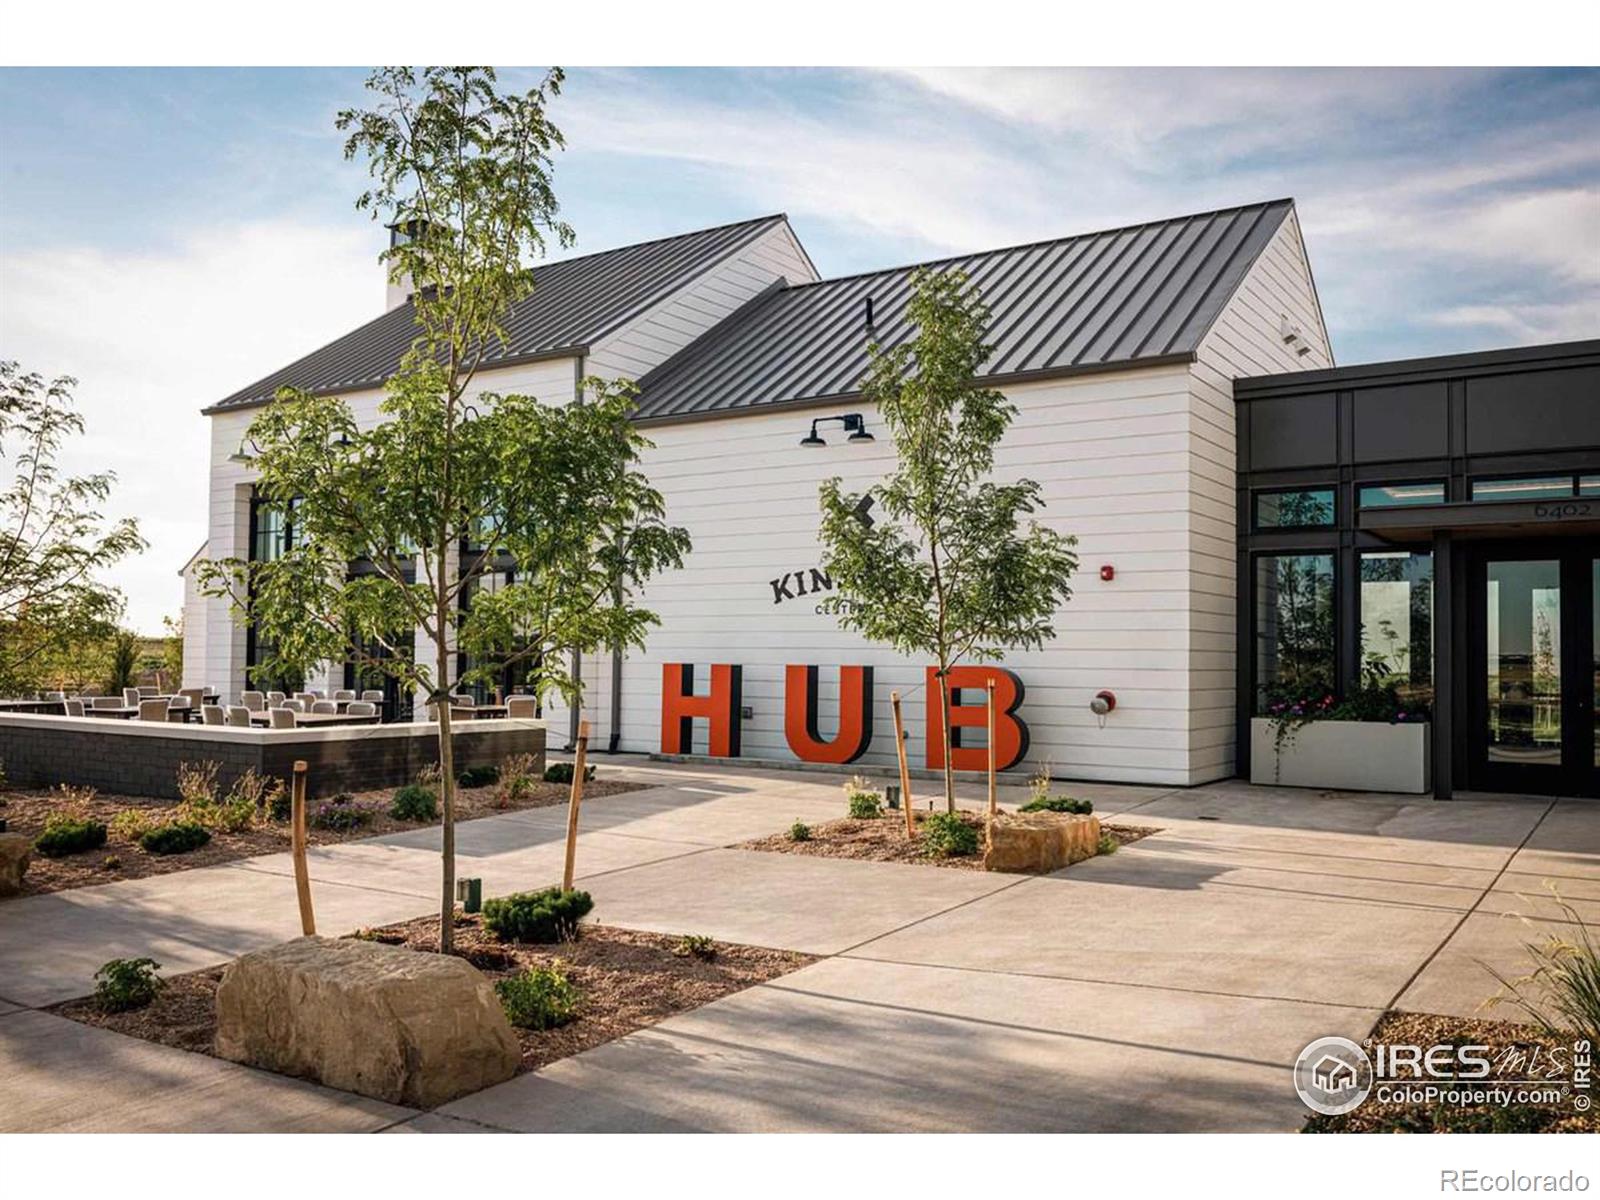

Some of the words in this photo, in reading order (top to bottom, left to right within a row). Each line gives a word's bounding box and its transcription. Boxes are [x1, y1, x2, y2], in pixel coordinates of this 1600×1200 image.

[1535, 504, 1592, 519] 6402
[769, 568, 841, 604] KIN
[661, 663, 1030, 771] HUB
